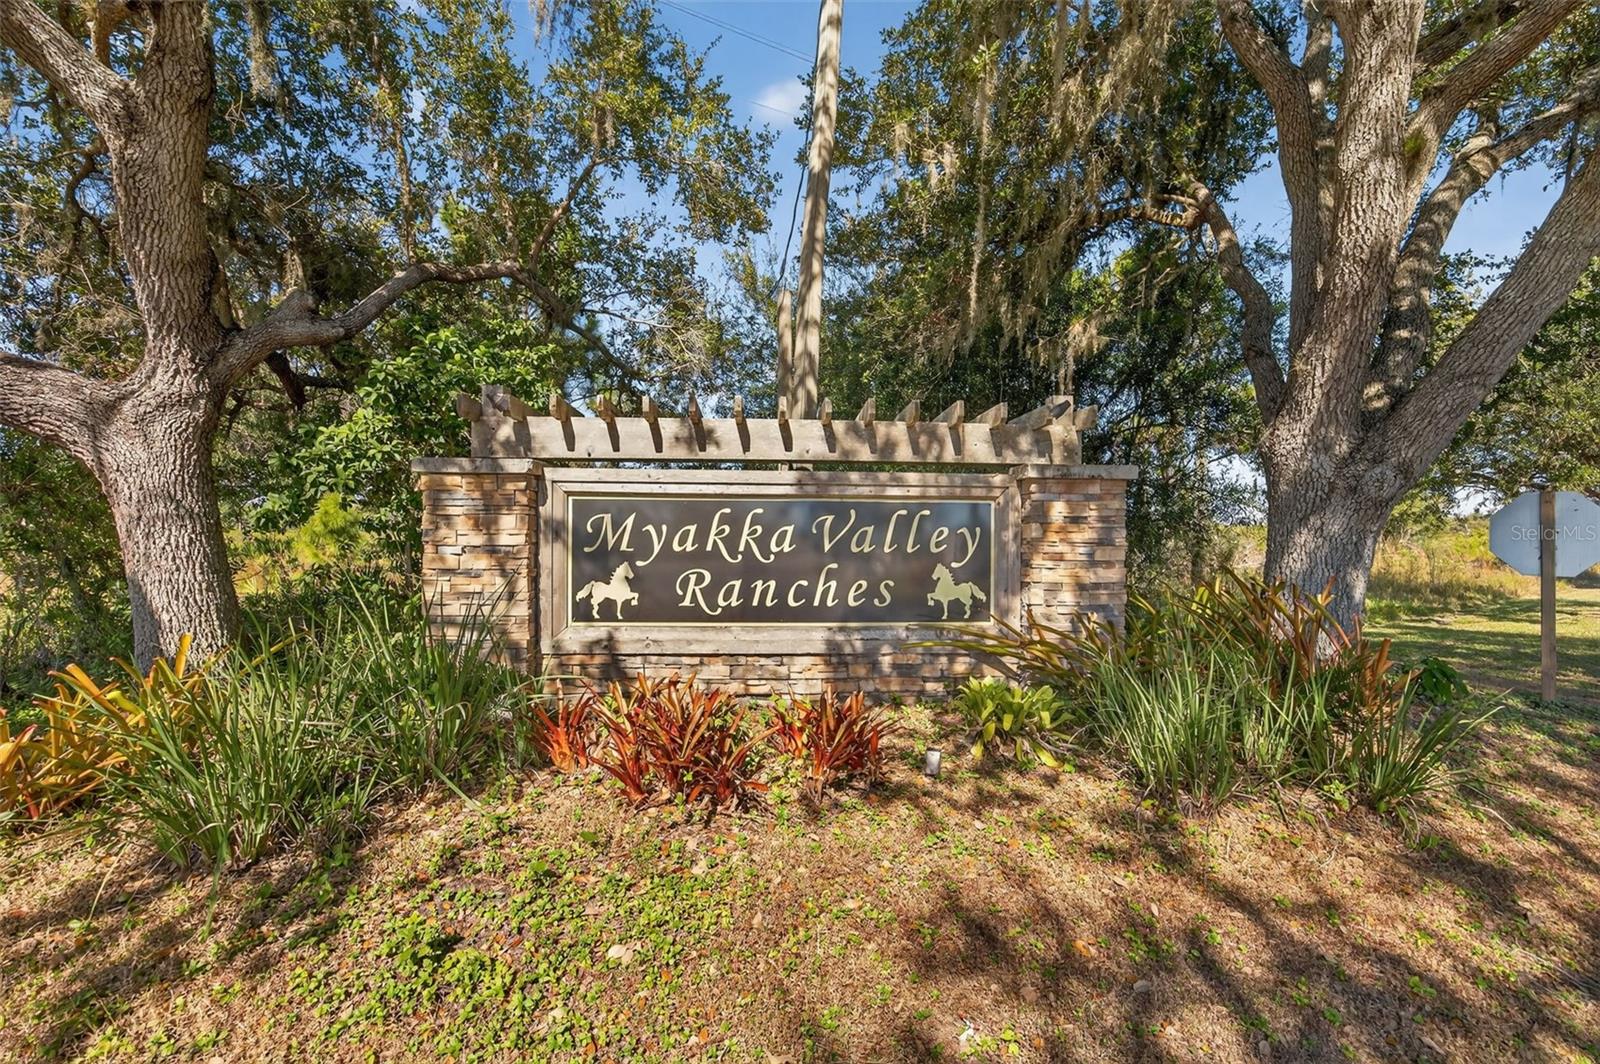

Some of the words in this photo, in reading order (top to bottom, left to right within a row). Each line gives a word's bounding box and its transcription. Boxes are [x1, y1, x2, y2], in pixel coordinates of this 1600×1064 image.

[583, 507, 797, 567] Myakka
[811, 508, 981, 569] Valley
[675, 562, 895, 616] Ranches
